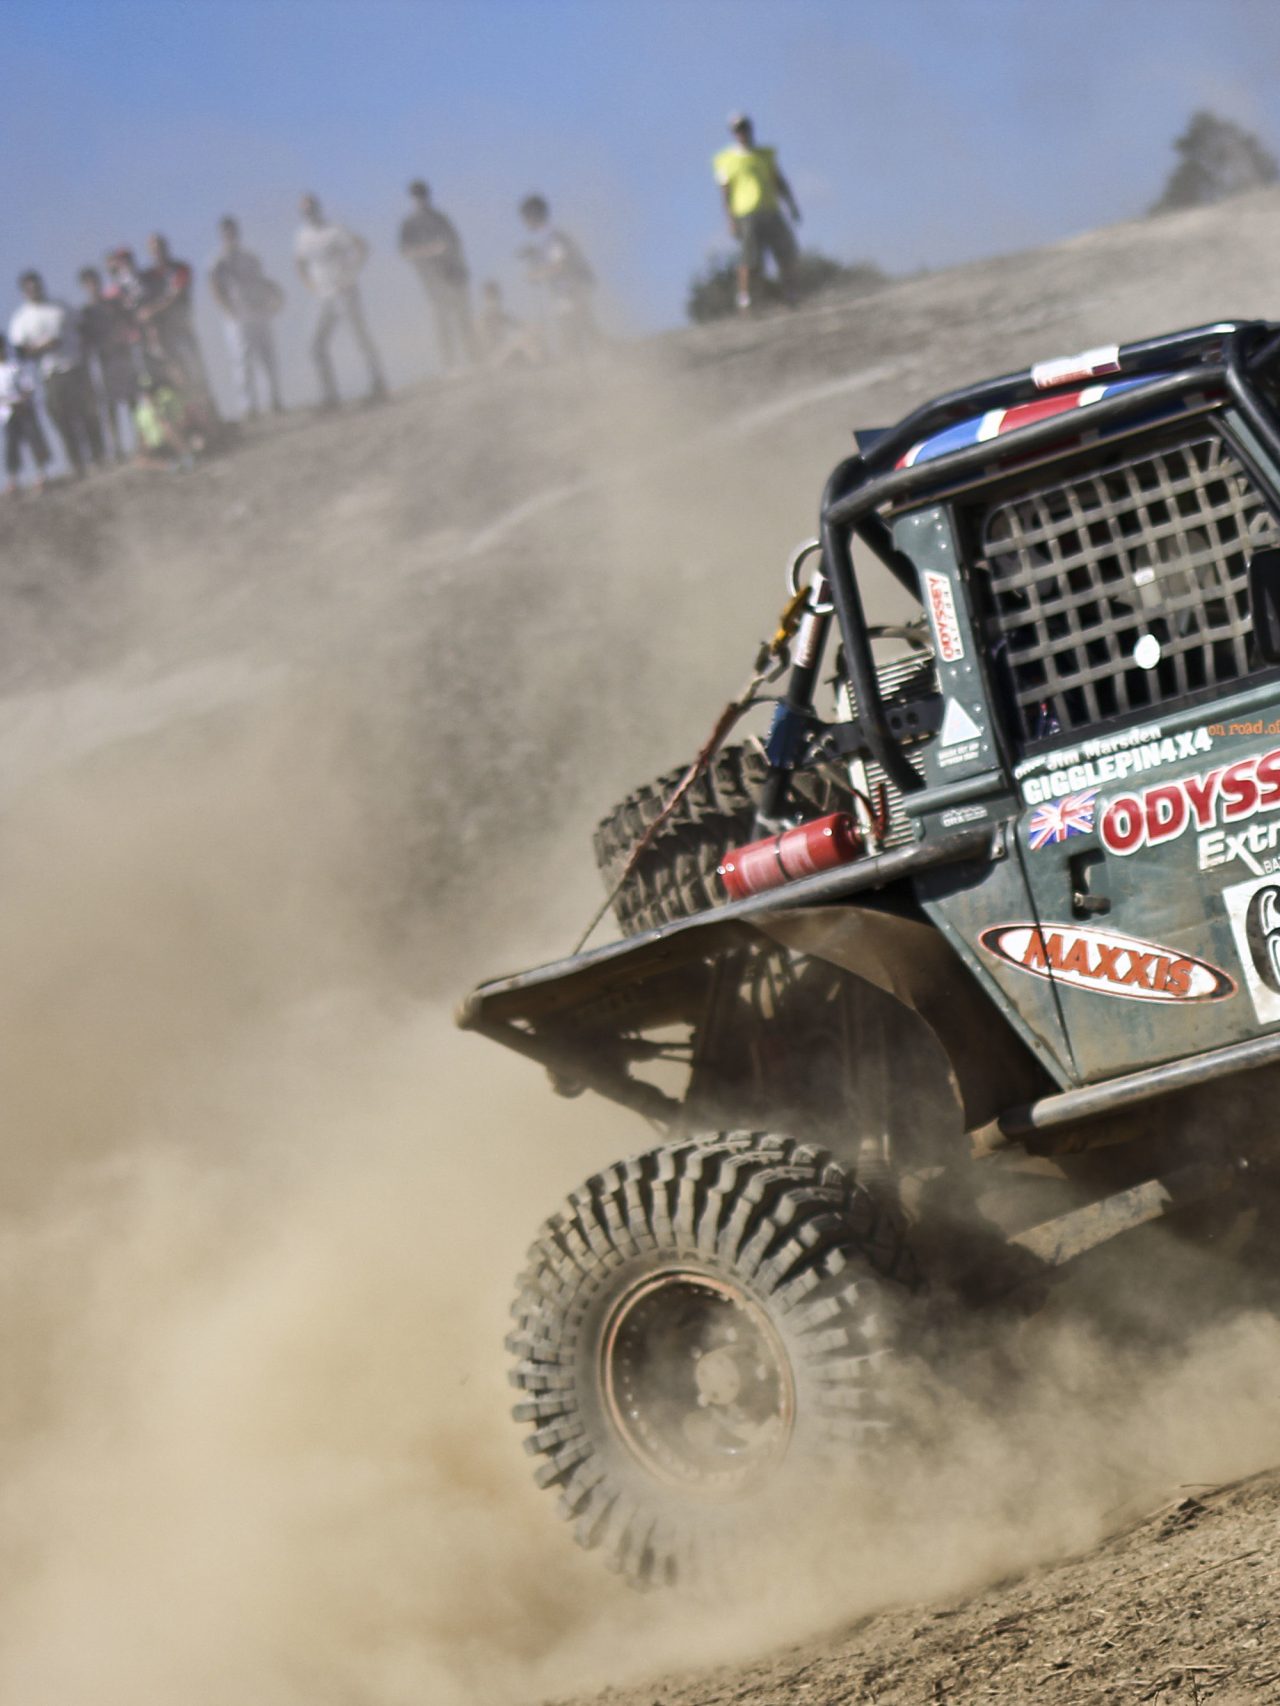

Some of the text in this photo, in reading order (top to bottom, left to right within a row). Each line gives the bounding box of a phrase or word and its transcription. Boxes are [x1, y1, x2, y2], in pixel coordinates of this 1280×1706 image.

[1081, 726, 1162, 757] Marsden
[1208, 724, 1224, 736] on
[1022, 726, 1214, 805] GIGGLEPIN4X4
[1021, 929, 1194, 997] MAXXIS
